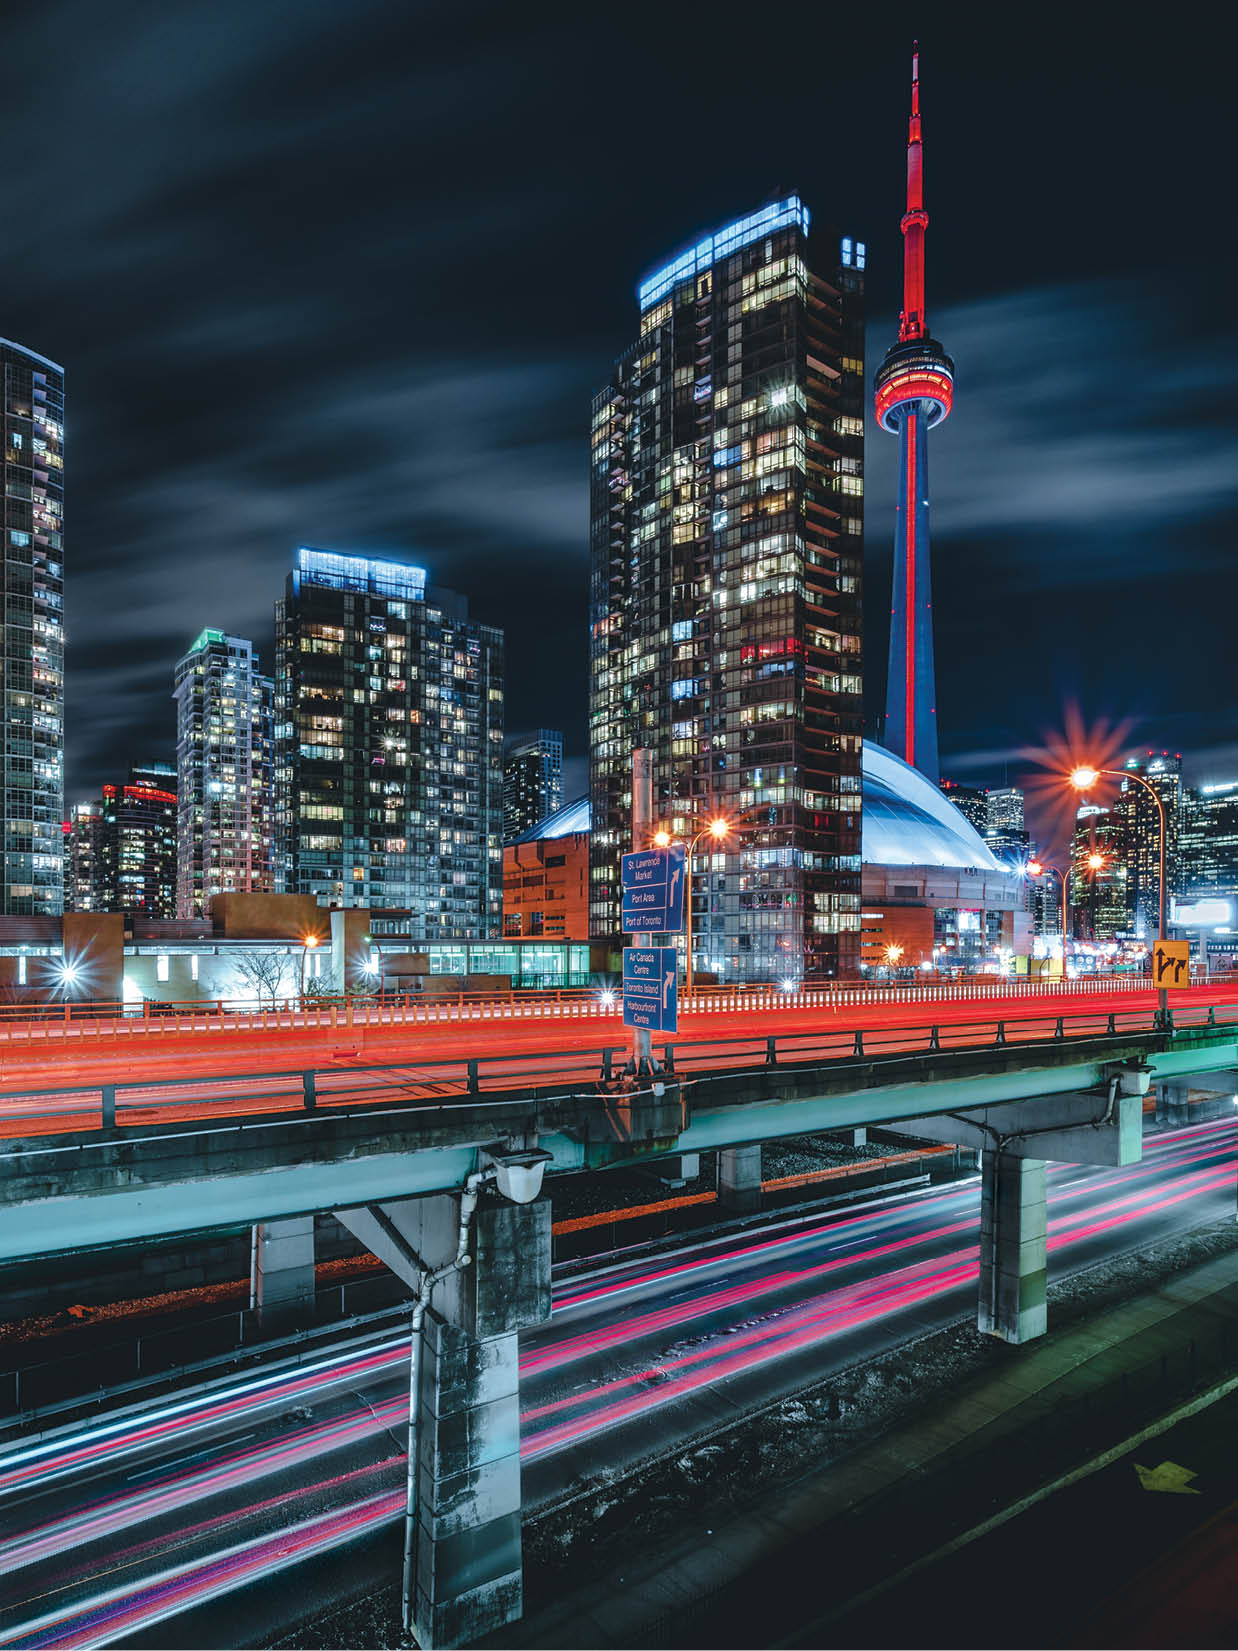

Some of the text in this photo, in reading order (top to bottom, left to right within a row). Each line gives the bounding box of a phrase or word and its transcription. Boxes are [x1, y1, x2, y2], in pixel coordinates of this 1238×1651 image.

[636, 857, 660, 869] Lawrence
[635, 870, 652, 880] Market
[632, 892, 655, 903] Port Area
[626, 917, 636, 926] Port
[642, 915, 661, 925] Toronto
[637, 952, 654, 962] Canada
[634, 964, 649, 974] Centre
[626, 982, 658, 994] Toronto Island
[627, 1000, 656, 1013] Harbourfront
[634, 1013, 649, 1024] Centre
